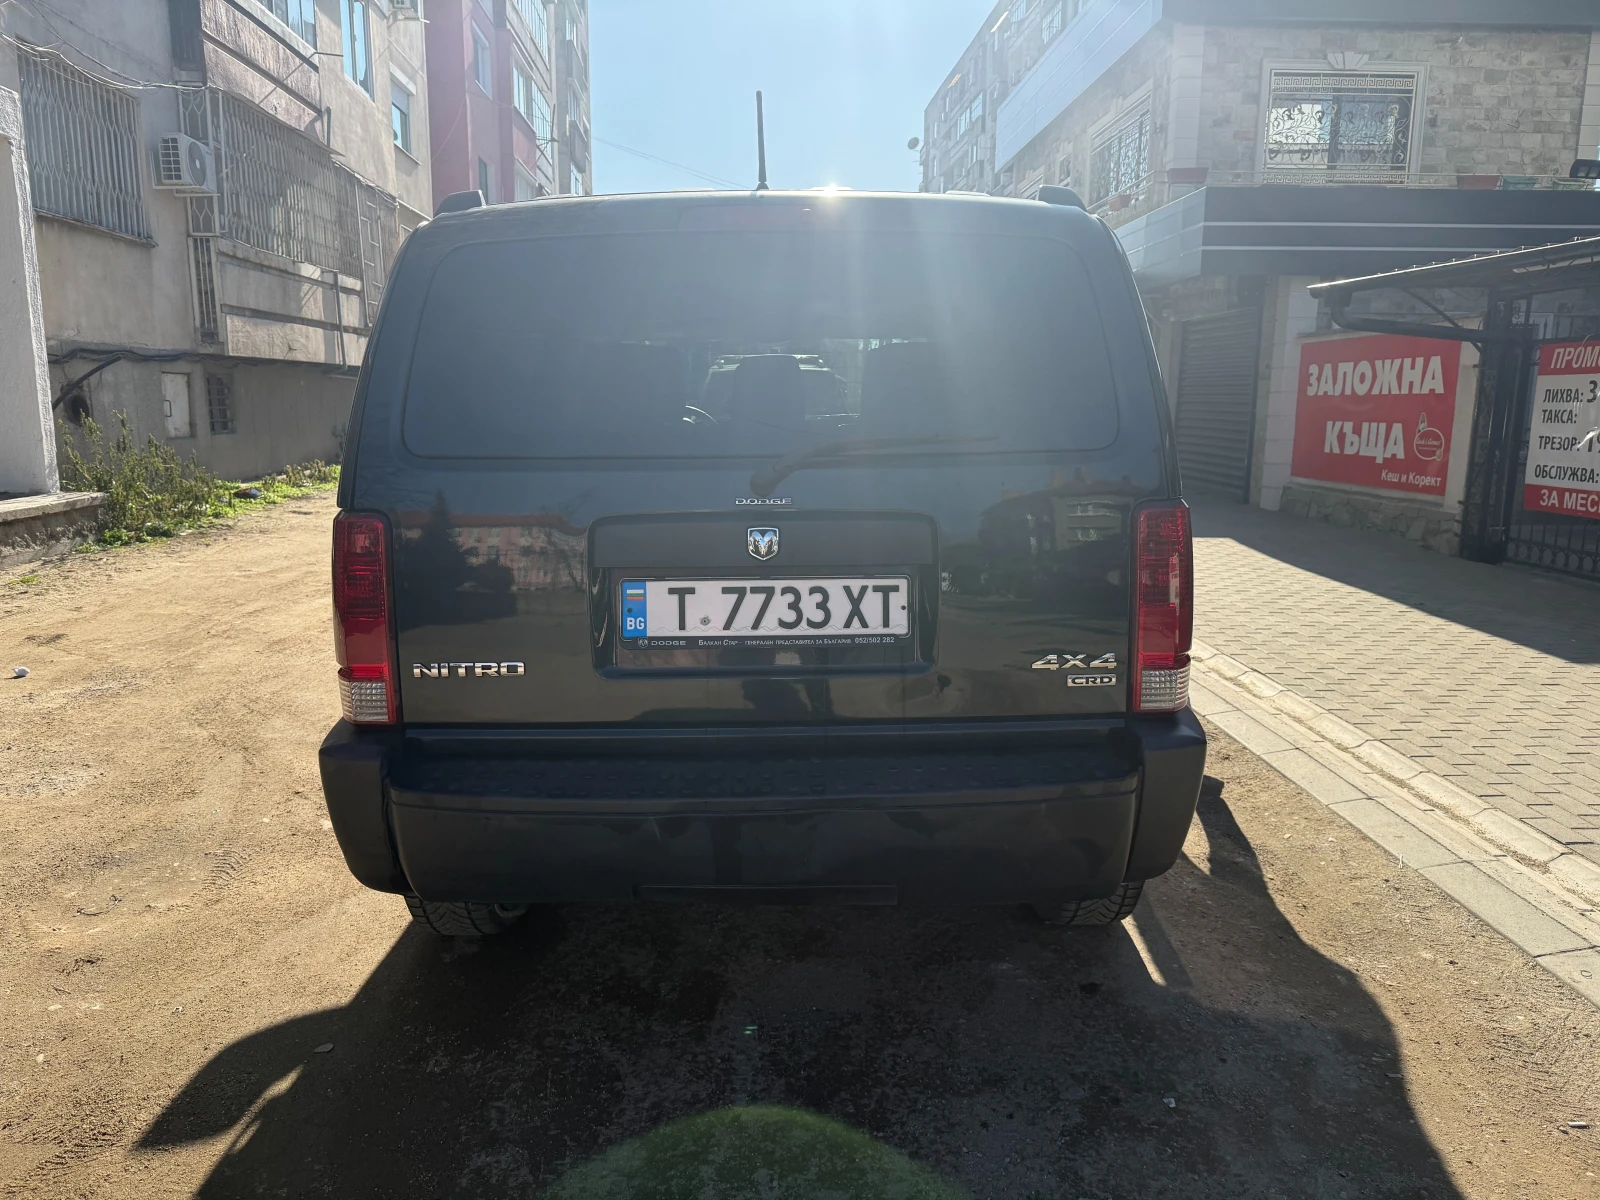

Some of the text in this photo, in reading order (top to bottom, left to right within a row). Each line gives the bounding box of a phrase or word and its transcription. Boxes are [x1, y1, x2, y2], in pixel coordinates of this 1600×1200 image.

[1551, 345, 1600, 369] ПРОМ
[1306, 355, 1445, 396] ЗАЛОЖНА
[1543, 388, 1584, 403] ЛИХВА:
[1542, 408, 1578, 424] ТАКСА:
[1324, 420, 1405, 464] КЪЩА
[1538, 435, 1581, 452] ТРЕЗОР:
[1381, 469, 1442, 488] Кеш и Корект
[1534, 464, 1600, 484] ОБСЛУЖВА:
[735, 497, 793, 505] DODGE
[1539, 488, 1600, 514] ЗА МЕС
[668, 585, 900, 631] T 7733 XT
[626, 617, 645, 630] BG
[413, 661, 525, 678] NITRO
[1031, 652, 1118, 671] 4X4
[1070, 676, 1114, 685] CRD
